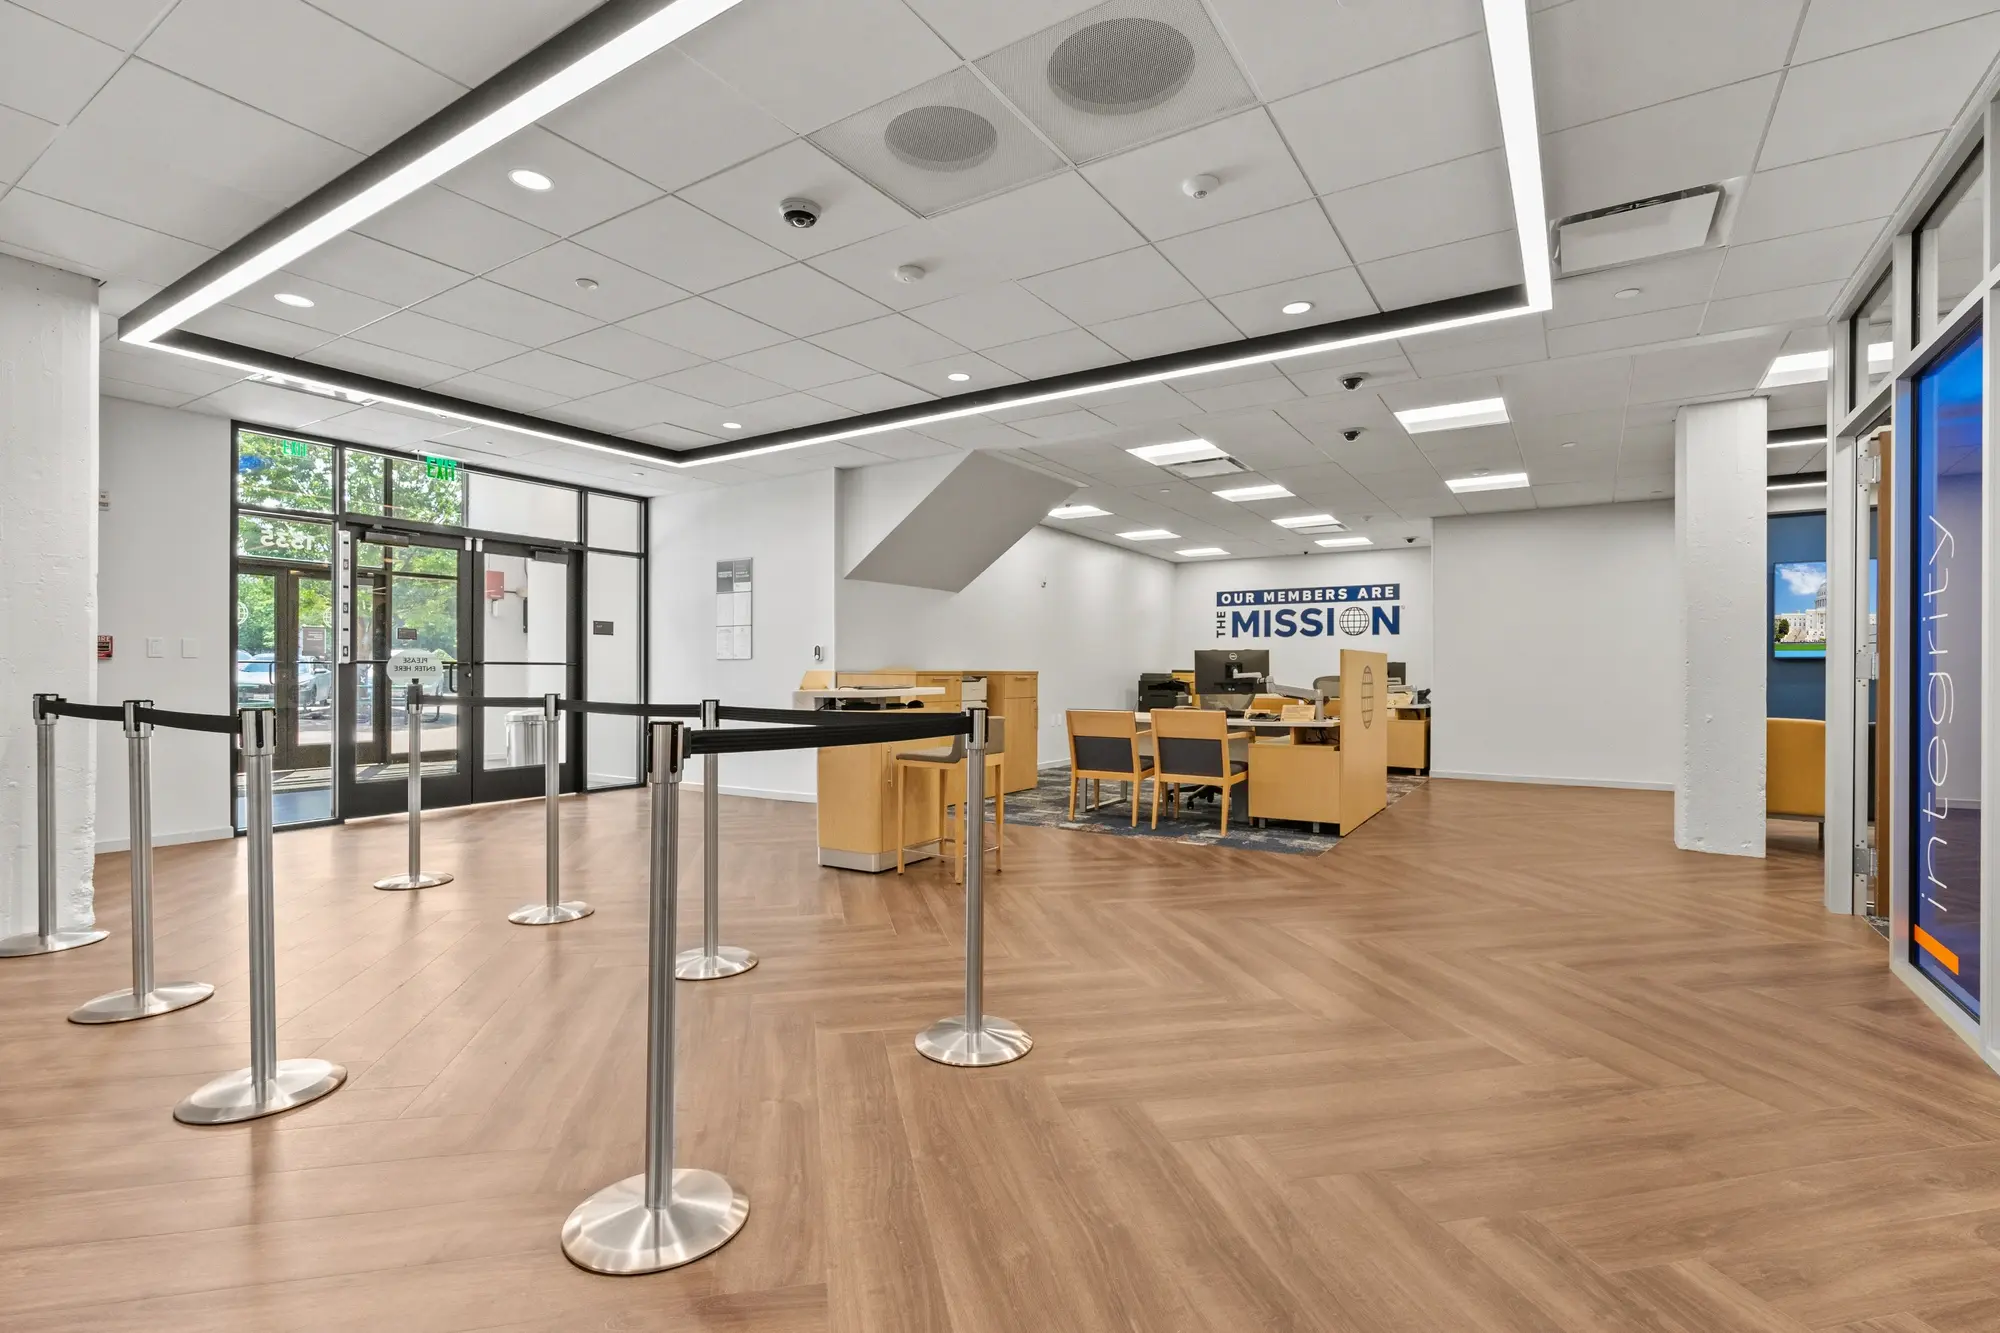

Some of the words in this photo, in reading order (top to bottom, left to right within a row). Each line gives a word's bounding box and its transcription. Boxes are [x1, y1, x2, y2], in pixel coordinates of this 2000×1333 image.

[427, 456, 457, 481] EXIT
[1221, 592, 1255, 604] OUR
[1264, 588, 1348, 603] MEMBERS
[1357, 586, 1394, 599] ARE
[1216, 611, 1226, 638] THE
[1921, 515, 1955, 912] integrity
